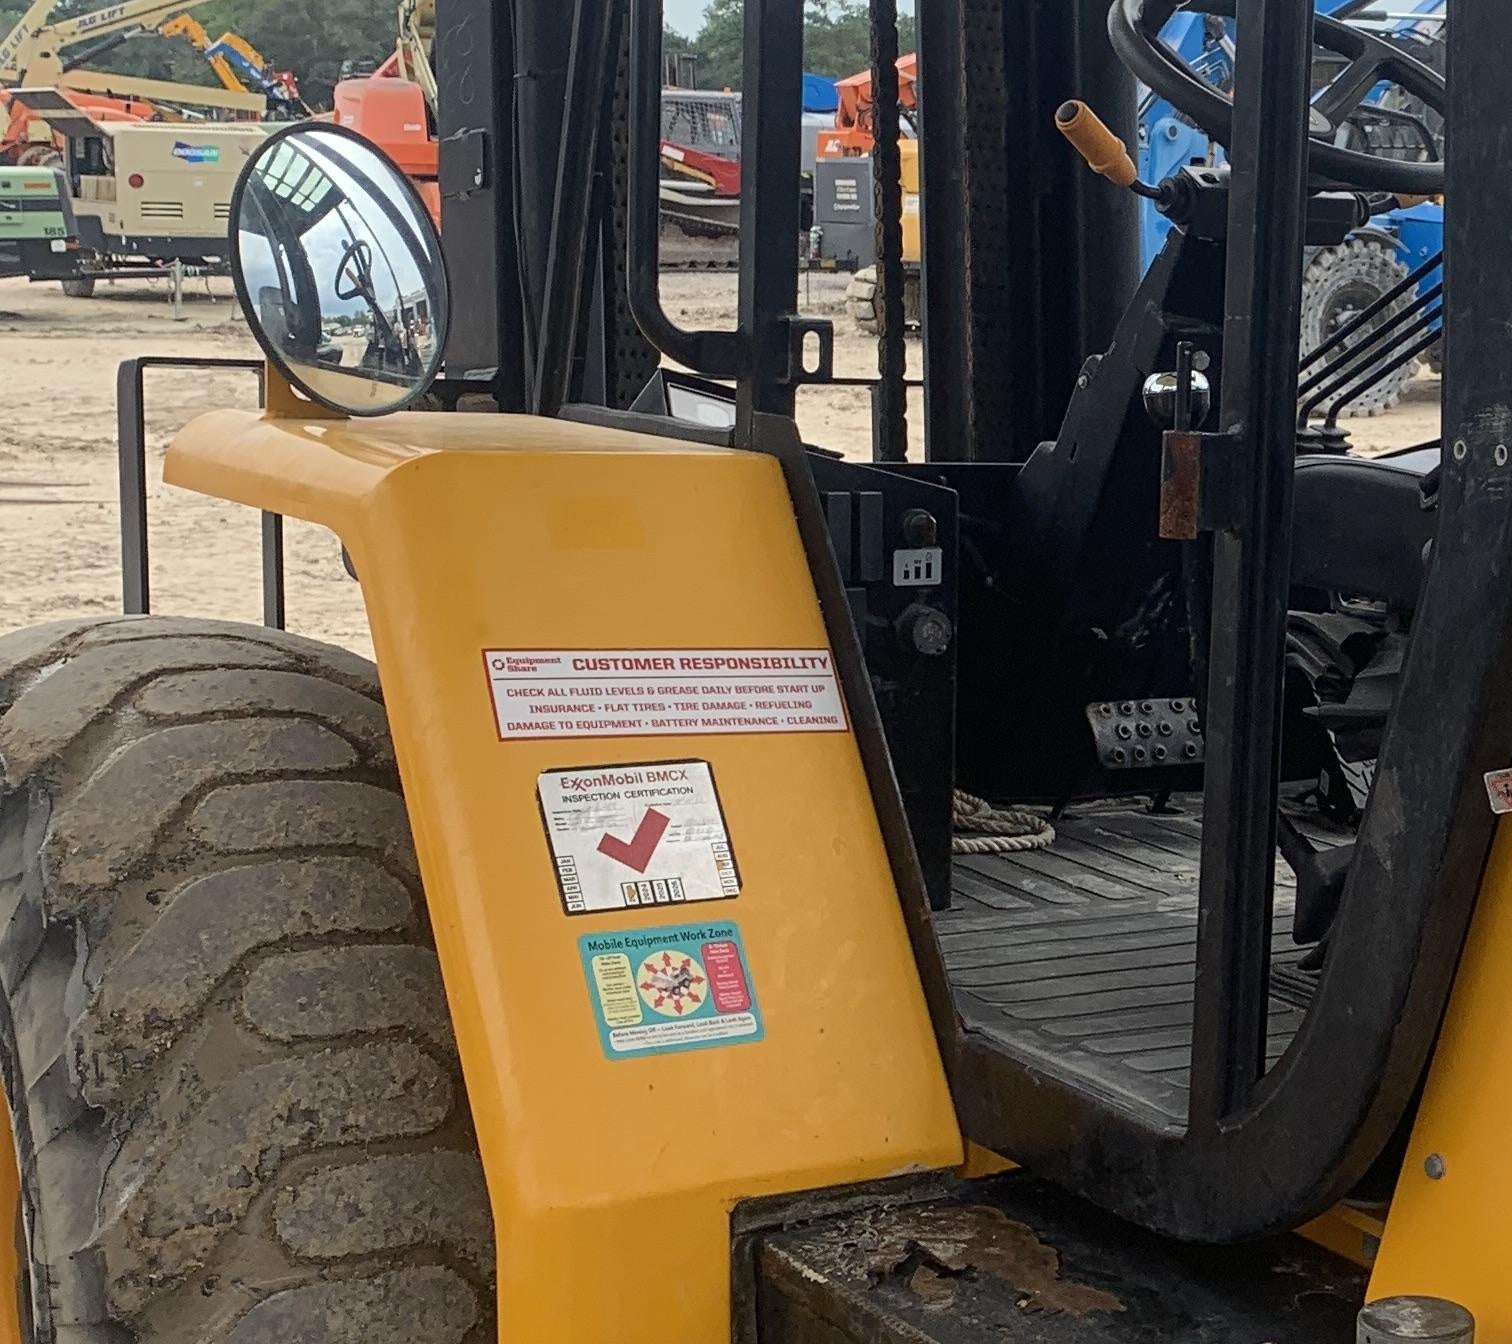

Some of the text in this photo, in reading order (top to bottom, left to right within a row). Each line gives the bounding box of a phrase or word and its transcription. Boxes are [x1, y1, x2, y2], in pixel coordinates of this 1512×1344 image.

[506, 657, 562, 666] Equipment
[572, 657, 828, 671] CUSTOMER RESPONSIBILITY
[507, 665, 538, 673] Share
[507, 688, 545, 698] CHECK
[547, 688, 567, 697] ALL
[569, 687, 602, 697] FLUID
[605, 686, 644, 696] LEVELS
[657, 686, 699, 695] GREASE
[702, 685, 732, 694] DAILY
[735, 685, 774, 694] BEFORE
[777, 685, 809, 693] START
[811, 685, 825, 693] UP
[529, 700, 813, 714] INSURANCE FLAT TIRES TIRE DAMAGE REFUELING
[507, 715, 839, 731] DAMAGE TO EQUIPMENT BATTERY MAINTENANCE CLEANING
[560, 768, 688, 792] ExxonMobil BMCX
[562, 786, 694, 804] INSPECTION CERTIFICATION
[587, 927, 734, 952] Mobile Equipment Work Zone
